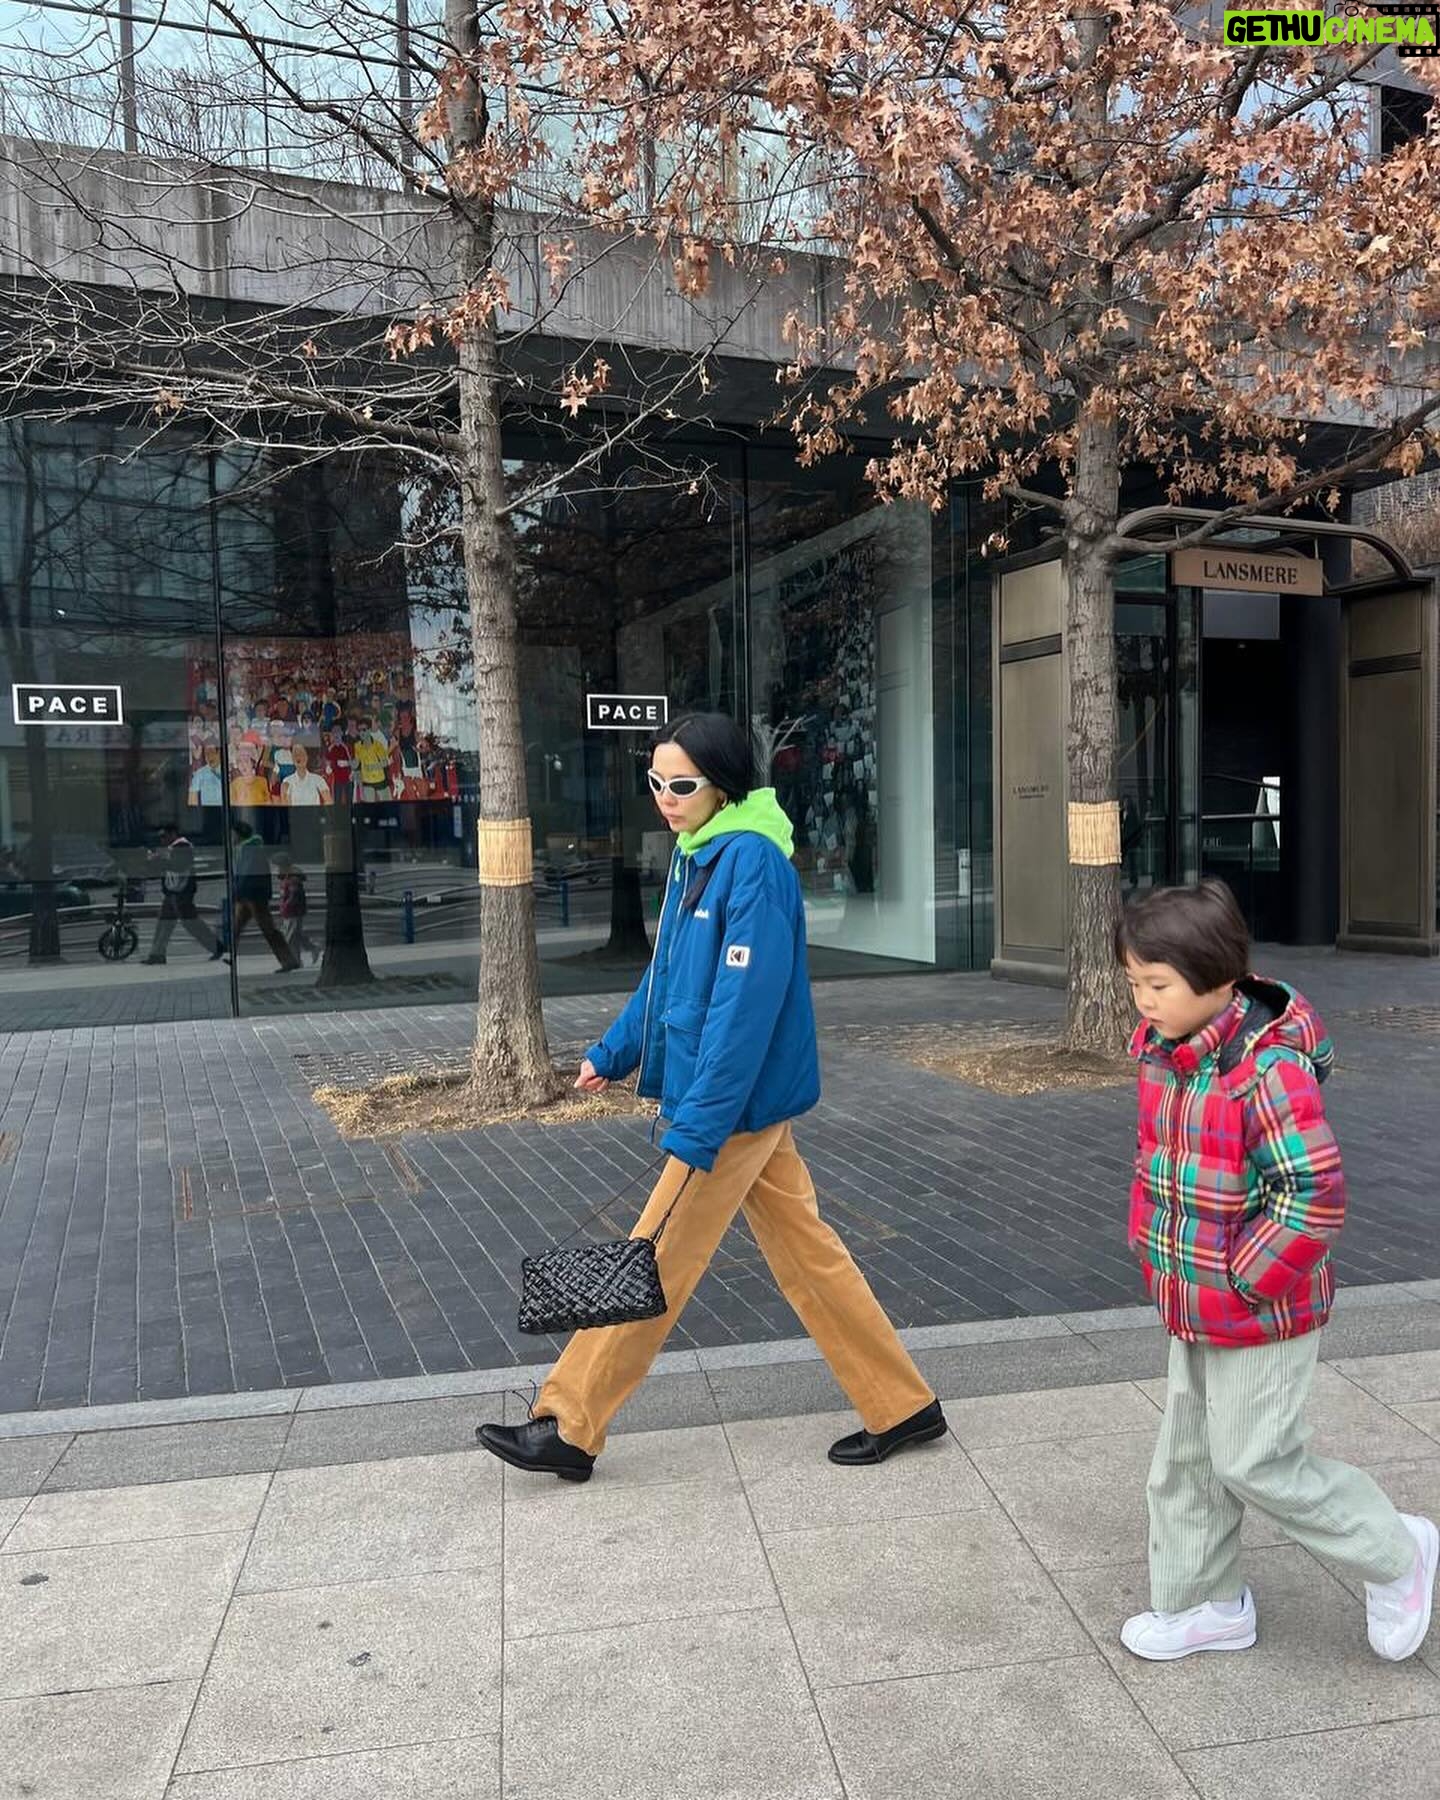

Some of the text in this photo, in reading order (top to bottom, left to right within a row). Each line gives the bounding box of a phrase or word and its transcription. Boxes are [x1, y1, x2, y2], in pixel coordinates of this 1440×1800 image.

[1203, 560, 1297, 585] LANSMERE
[28, 696, 108, 713] PACE
[598, 704, 657, 720] PACE
